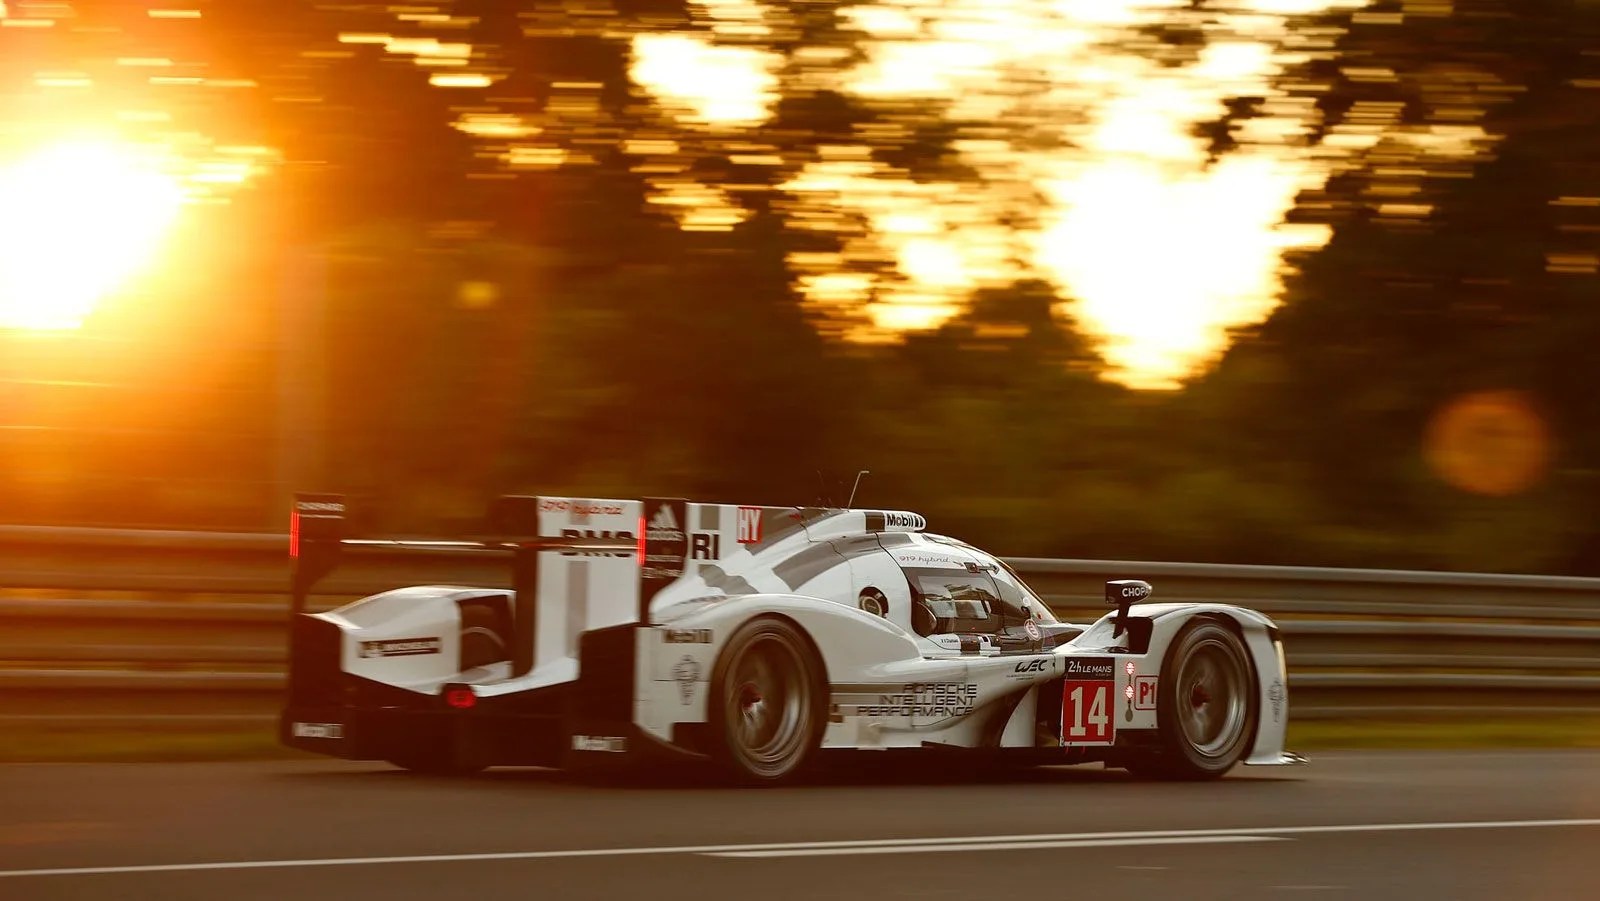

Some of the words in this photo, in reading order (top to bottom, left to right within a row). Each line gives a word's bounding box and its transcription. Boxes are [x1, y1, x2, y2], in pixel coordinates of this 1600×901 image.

[739, 509, 762, 541] HY
[886, 513, 914, 528] Mobil
[918, 555, 950, 565] hybrid
[1015, 659, 1048, 673] WEC
[1082, 665, 1091, 673] LE
[1091, 665, 1112, 673] MANS
[903, 684, 977, 695] PORSCHE
[1139, 682, 1156, 704] P1
[879, 695, 977, 706] INTELLIGENT
[857, 706, 973, 717] PERFORMANCE
[1070, 686, 1109, 737] 14
